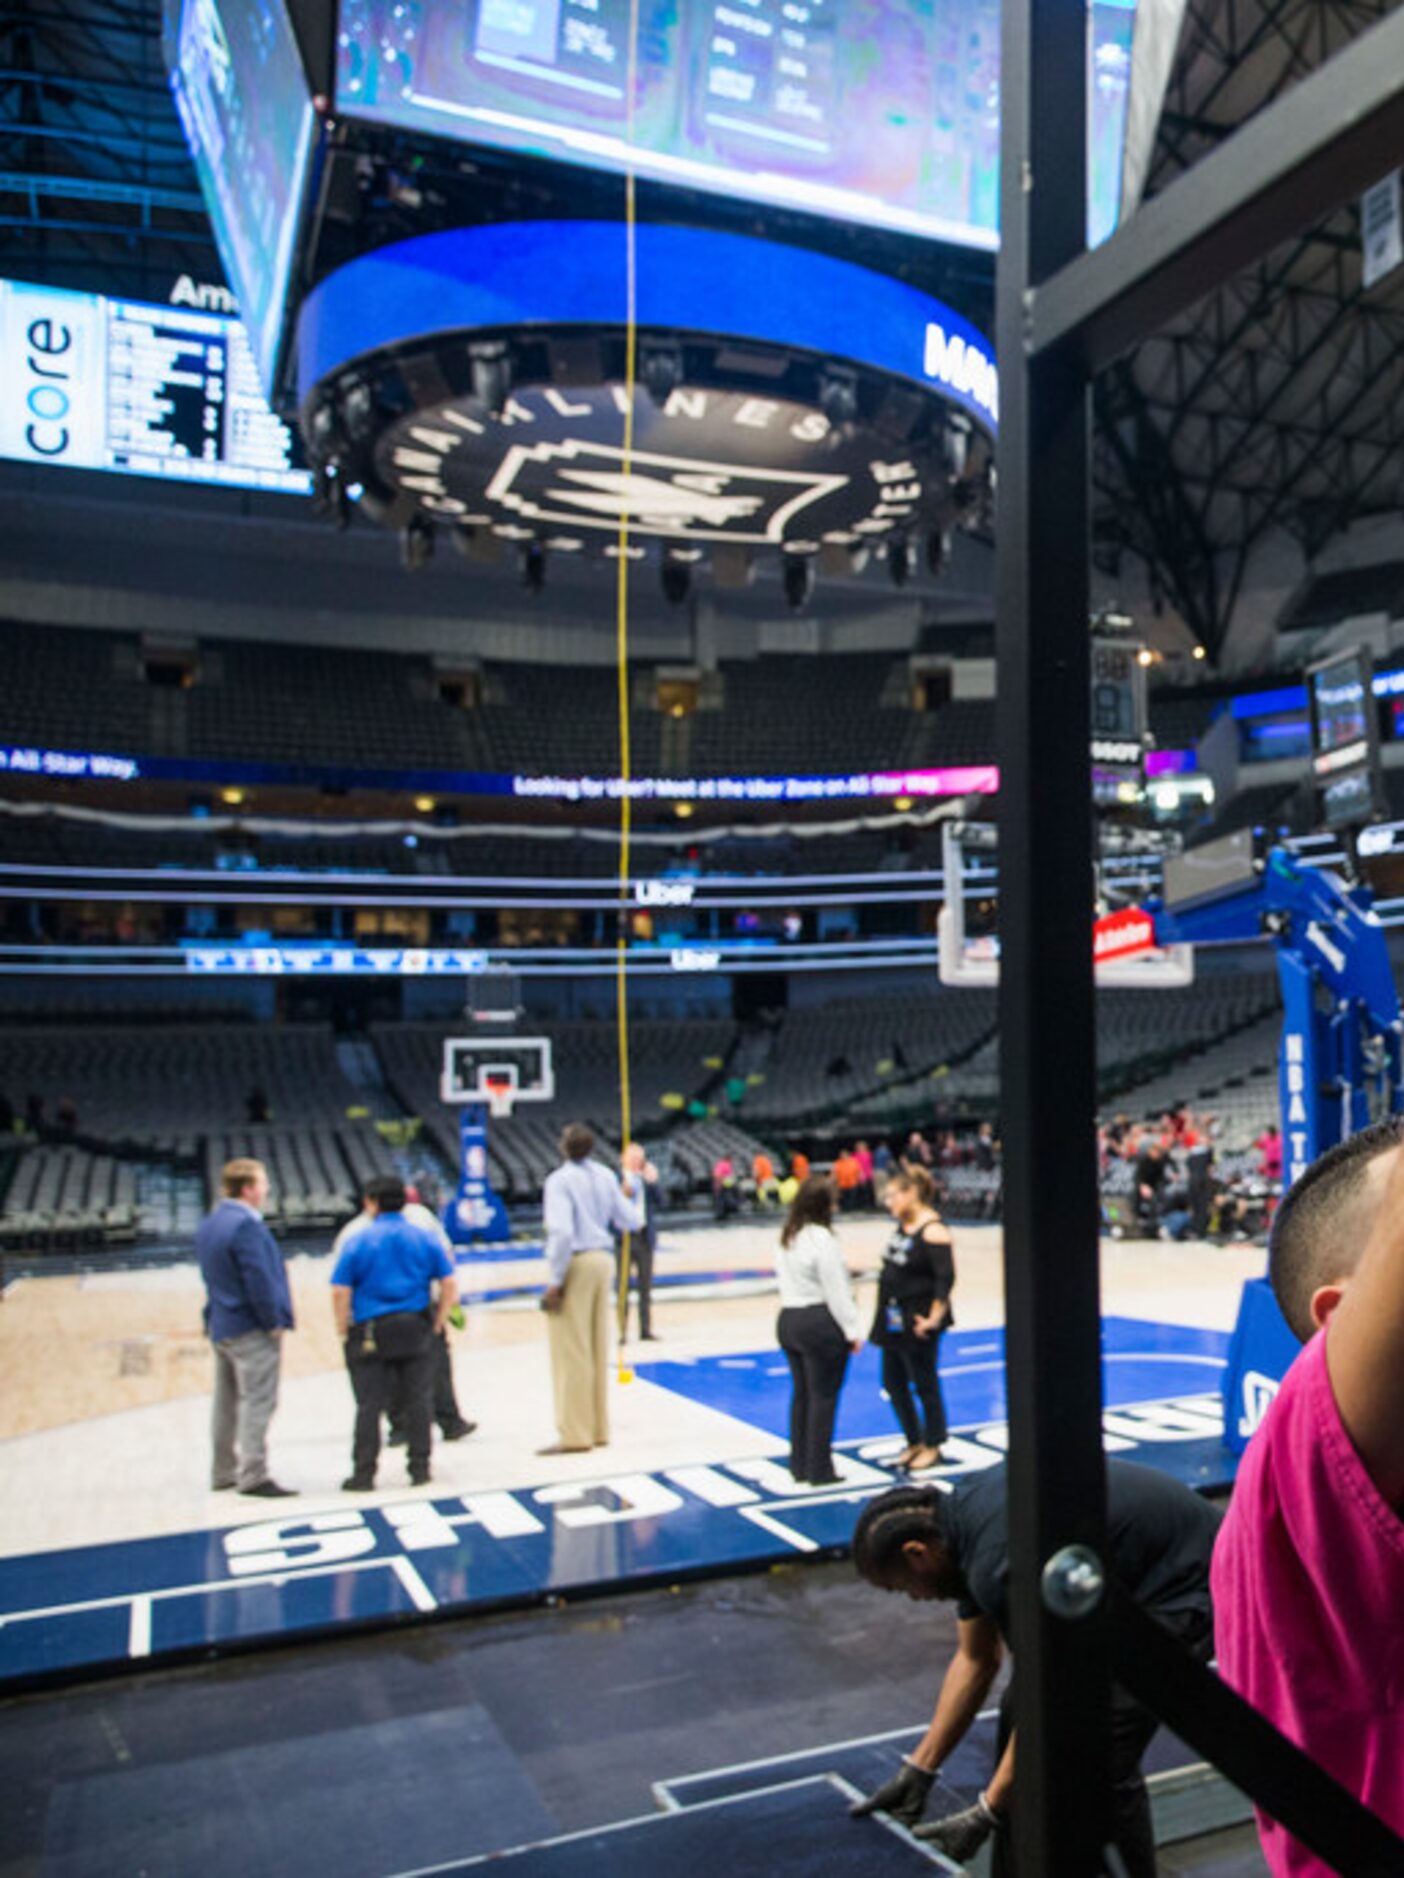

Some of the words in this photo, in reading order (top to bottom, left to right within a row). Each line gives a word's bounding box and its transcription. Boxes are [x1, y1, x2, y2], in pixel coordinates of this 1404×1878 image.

[26, 317, 71, 456] core
[513, 774, 579, 801] Looking
[635, 879, 695, 906] Uber
[671, 948, 720, 971] Uber
[1285, 1033, 1307, 1123] NBA
